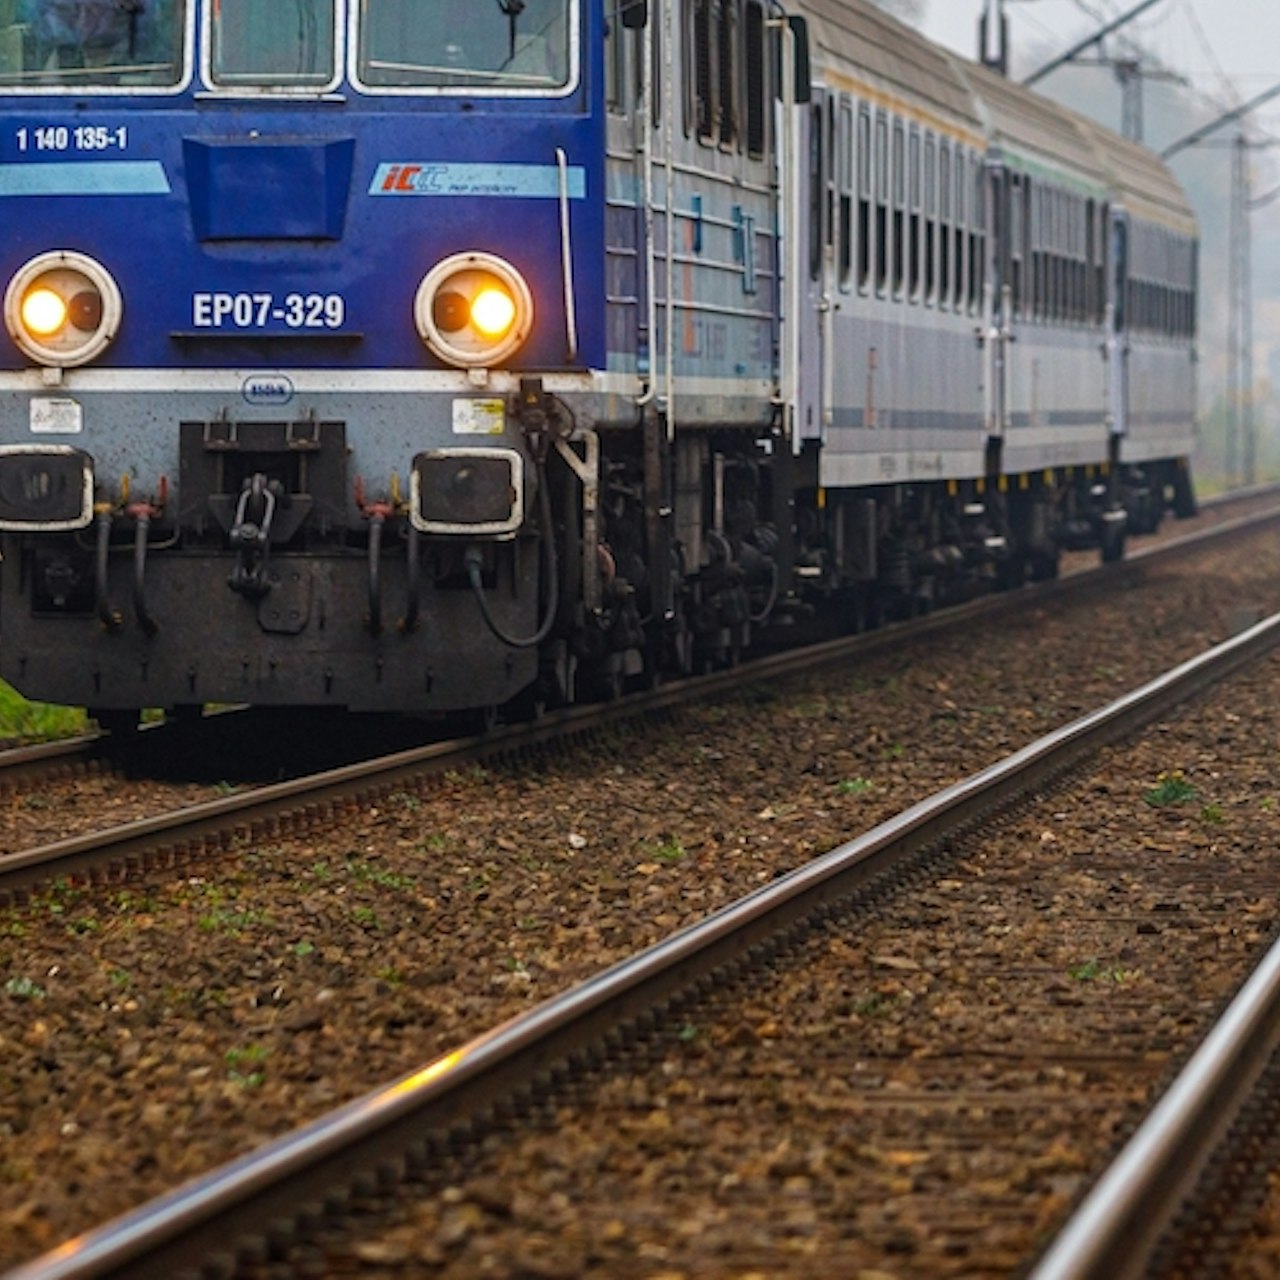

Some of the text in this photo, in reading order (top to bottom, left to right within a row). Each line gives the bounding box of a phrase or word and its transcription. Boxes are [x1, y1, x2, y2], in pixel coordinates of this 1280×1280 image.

[16, 126, 127, 151] 1 140 135-1
[193, 292, 345, 328] EP07-329
